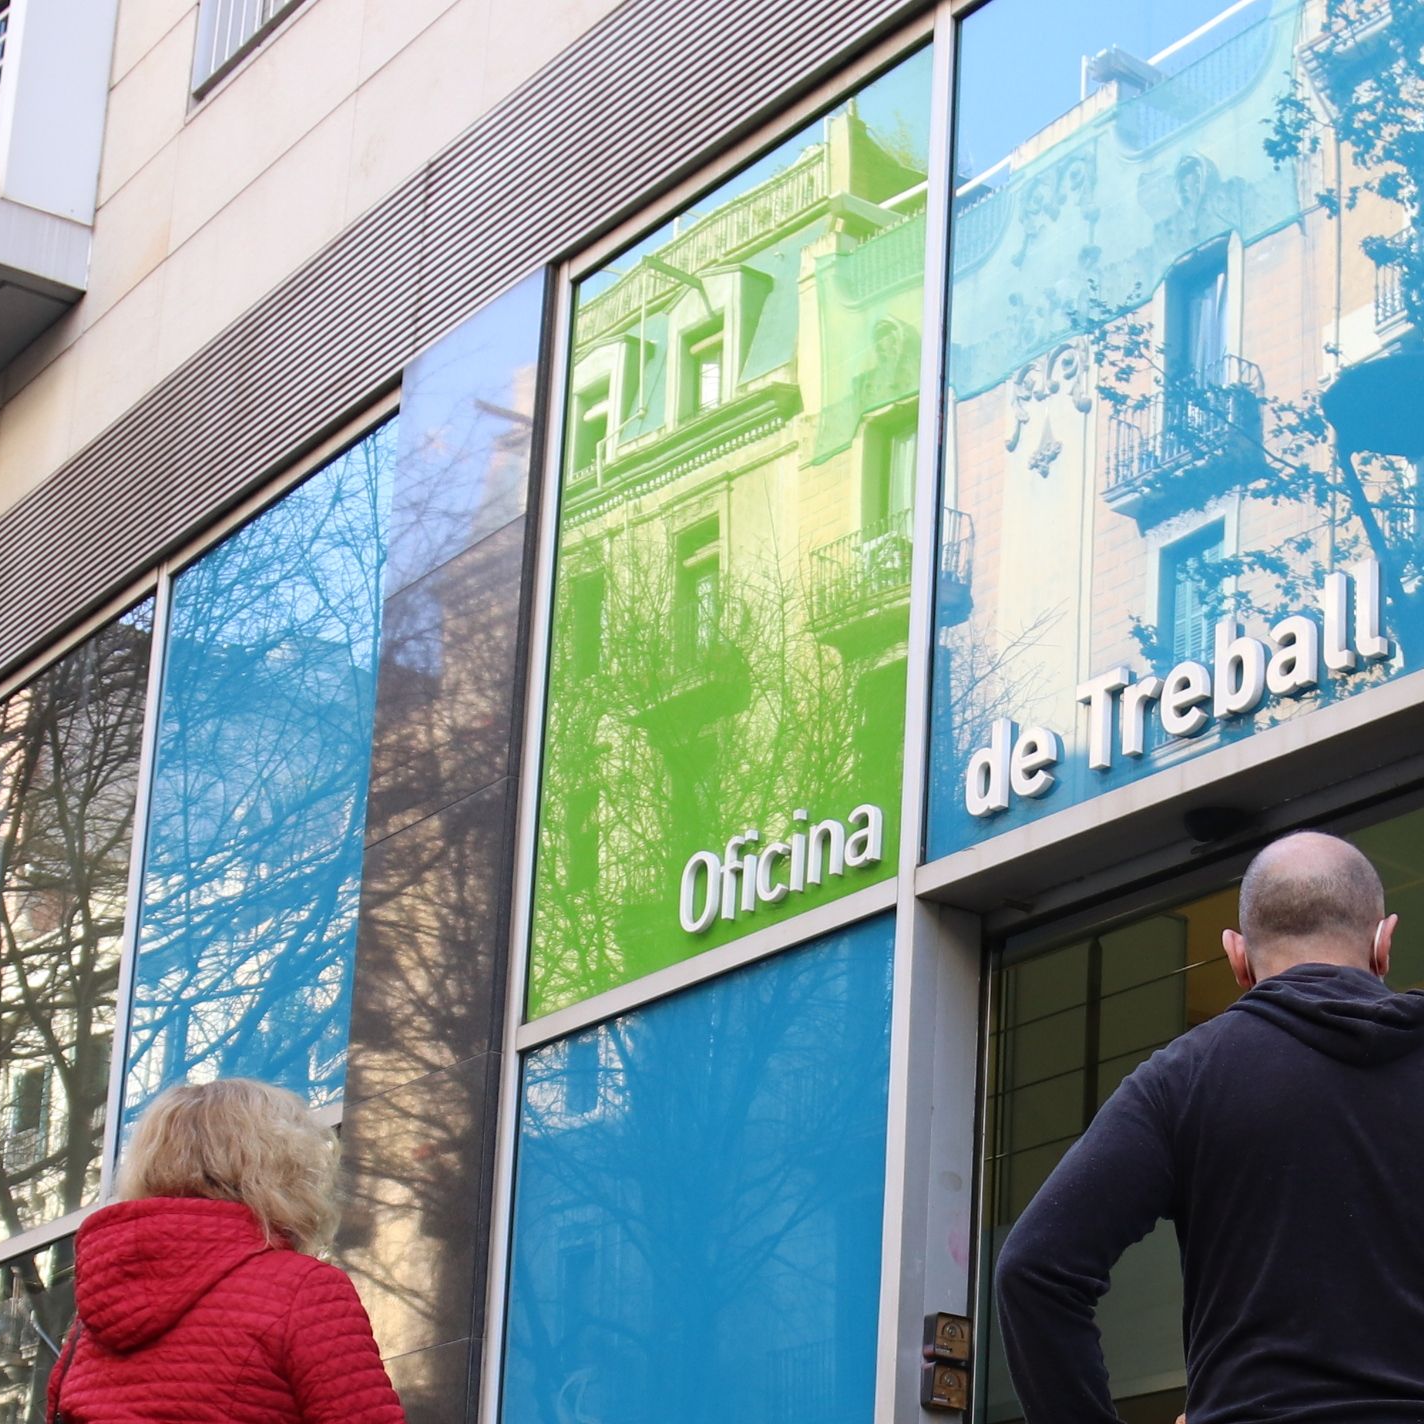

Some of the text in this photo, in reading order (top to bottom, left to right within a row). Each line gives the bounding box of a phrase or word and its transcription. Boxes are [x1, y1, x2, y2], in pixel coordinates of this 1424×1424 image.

[679, 558, 1395, 935] Oficina de Treball
